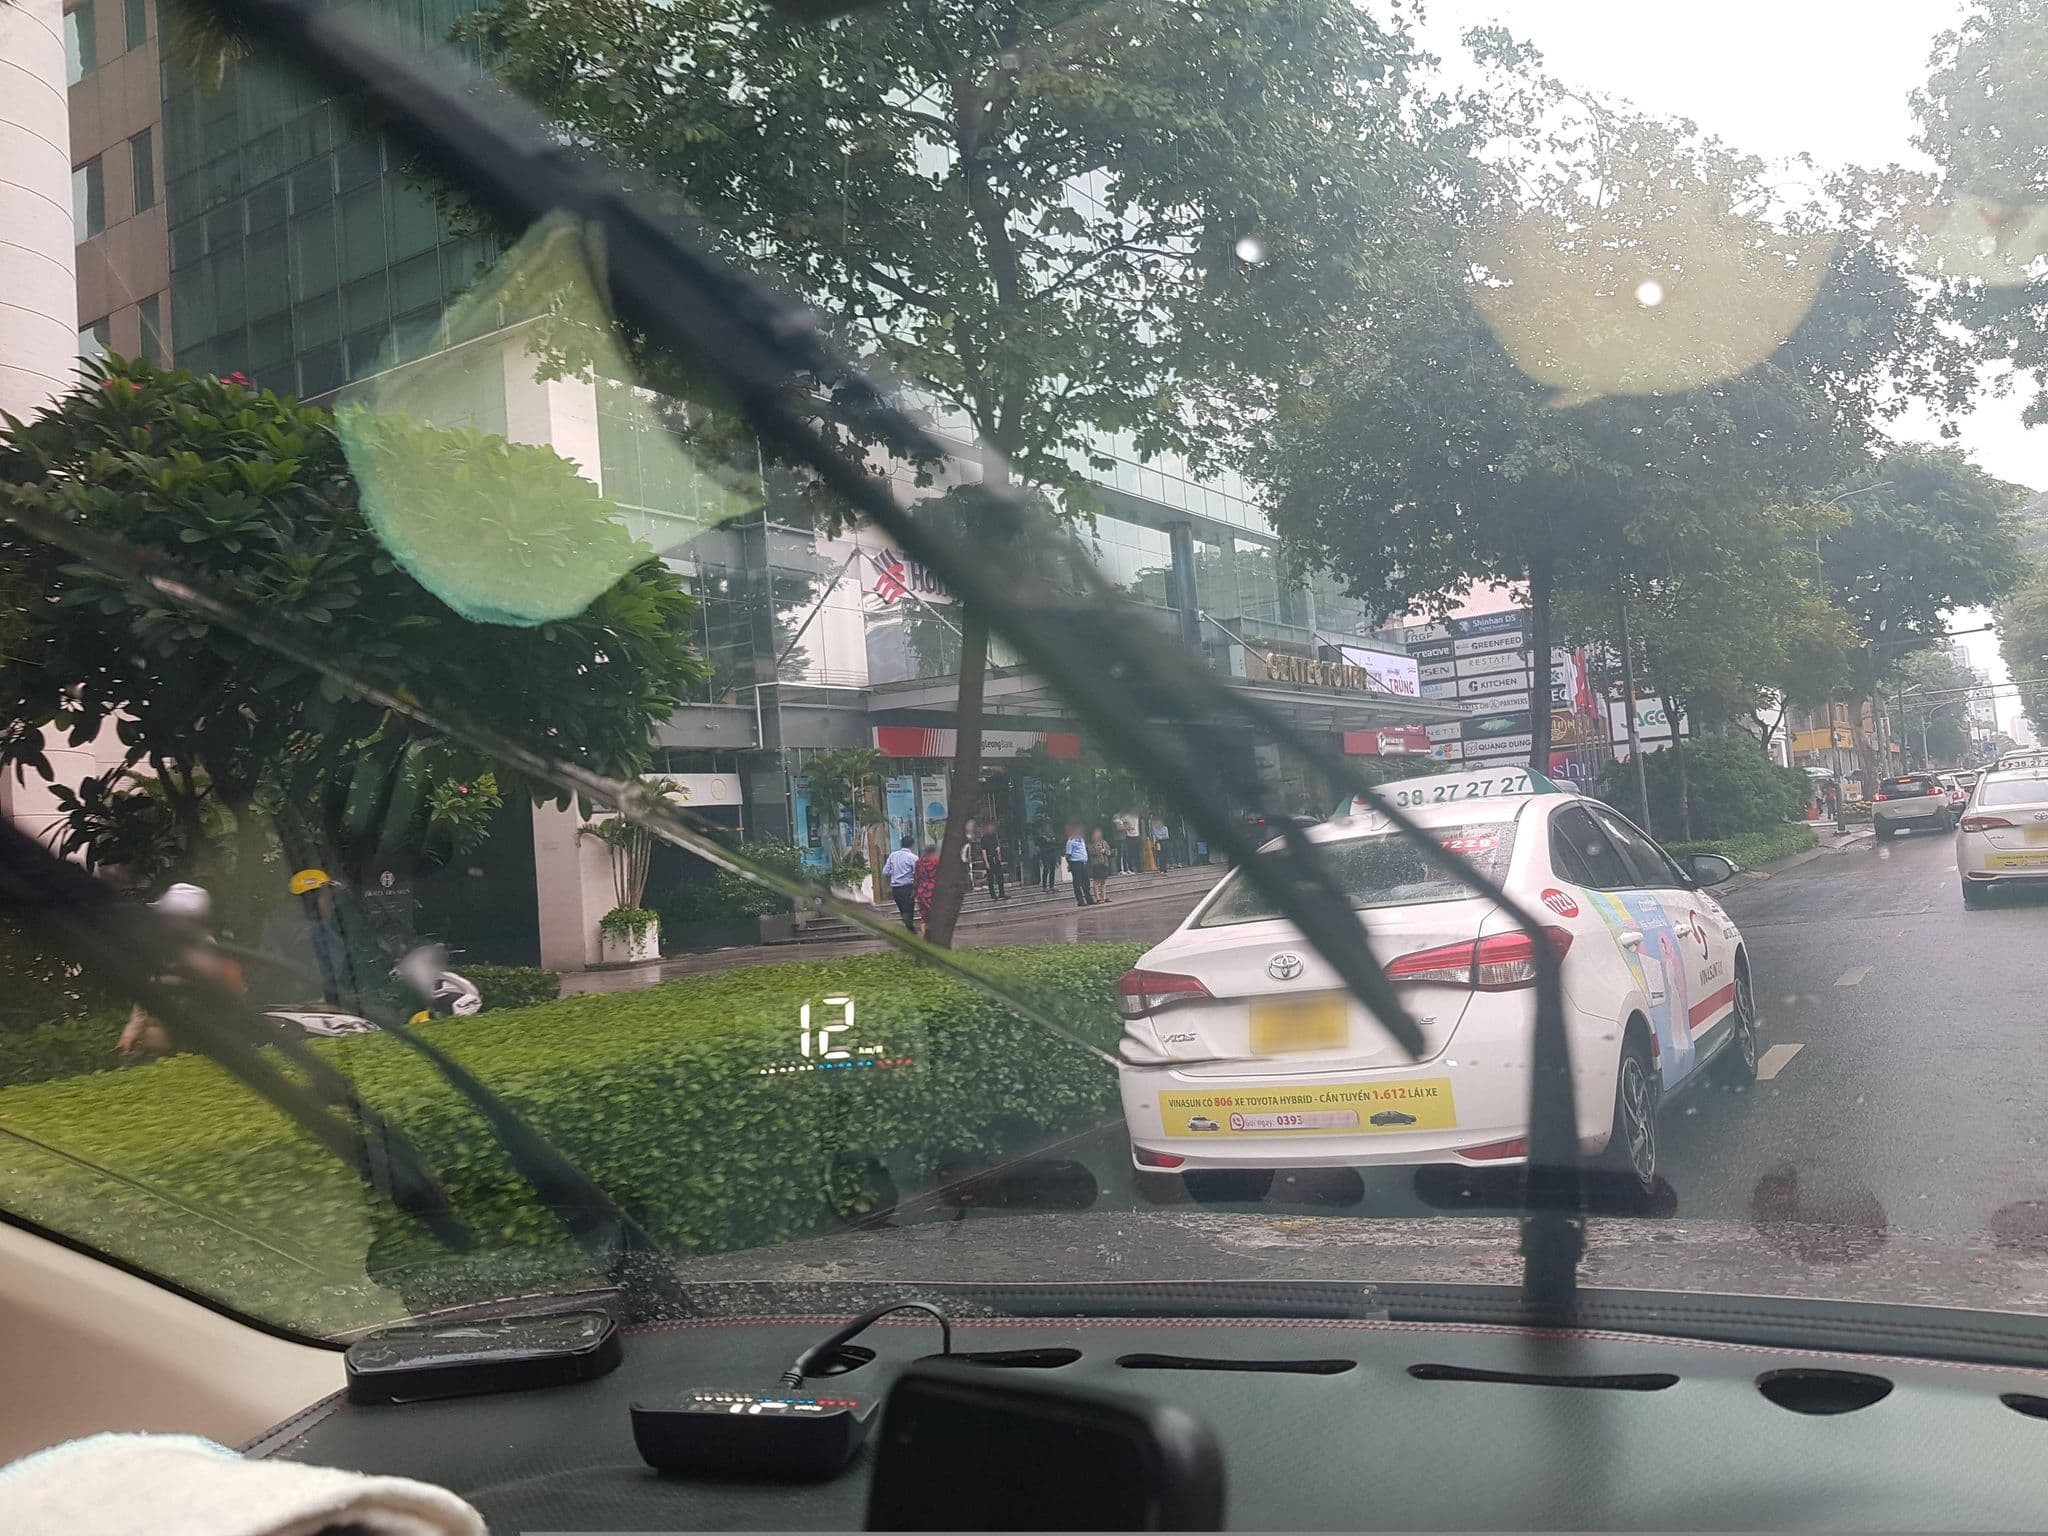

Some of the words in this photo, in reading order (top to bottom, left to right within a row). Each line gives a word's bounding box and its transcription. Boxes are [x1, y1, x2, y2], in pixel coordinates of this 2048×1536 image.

[1472, 617, 1504, 627] Shinhan
[1471, 636, 1522, 650] GREENFEED
[1469, 655, 1512, 667] RESTAFF
[1480, 678, 1517, 689] KITCHEN
[1478, 742, 1508, 751] QUANG
[1508, 740, 1531, 749] DUNG
[1466, 780, 1493, 798] 27
[1500, 775, 1528, 793] 27
[800, 996, 855, 1060] 12
[1168, 1098, 1201, 1108] VINASUN
[1214, 1096, 1233, 1107] 806
[1234, 1097, 1245, 1106] XE
[1245, 1096, 1279, 1106] TOYOTA
[1279, 1095, 1313, 1105] HYBRID
[1372, 1087, 1406, 1100] 1.612
[1408, 1087, 1424, 1099] LÁI
[1425, 1087, 1438, 1097] XE
